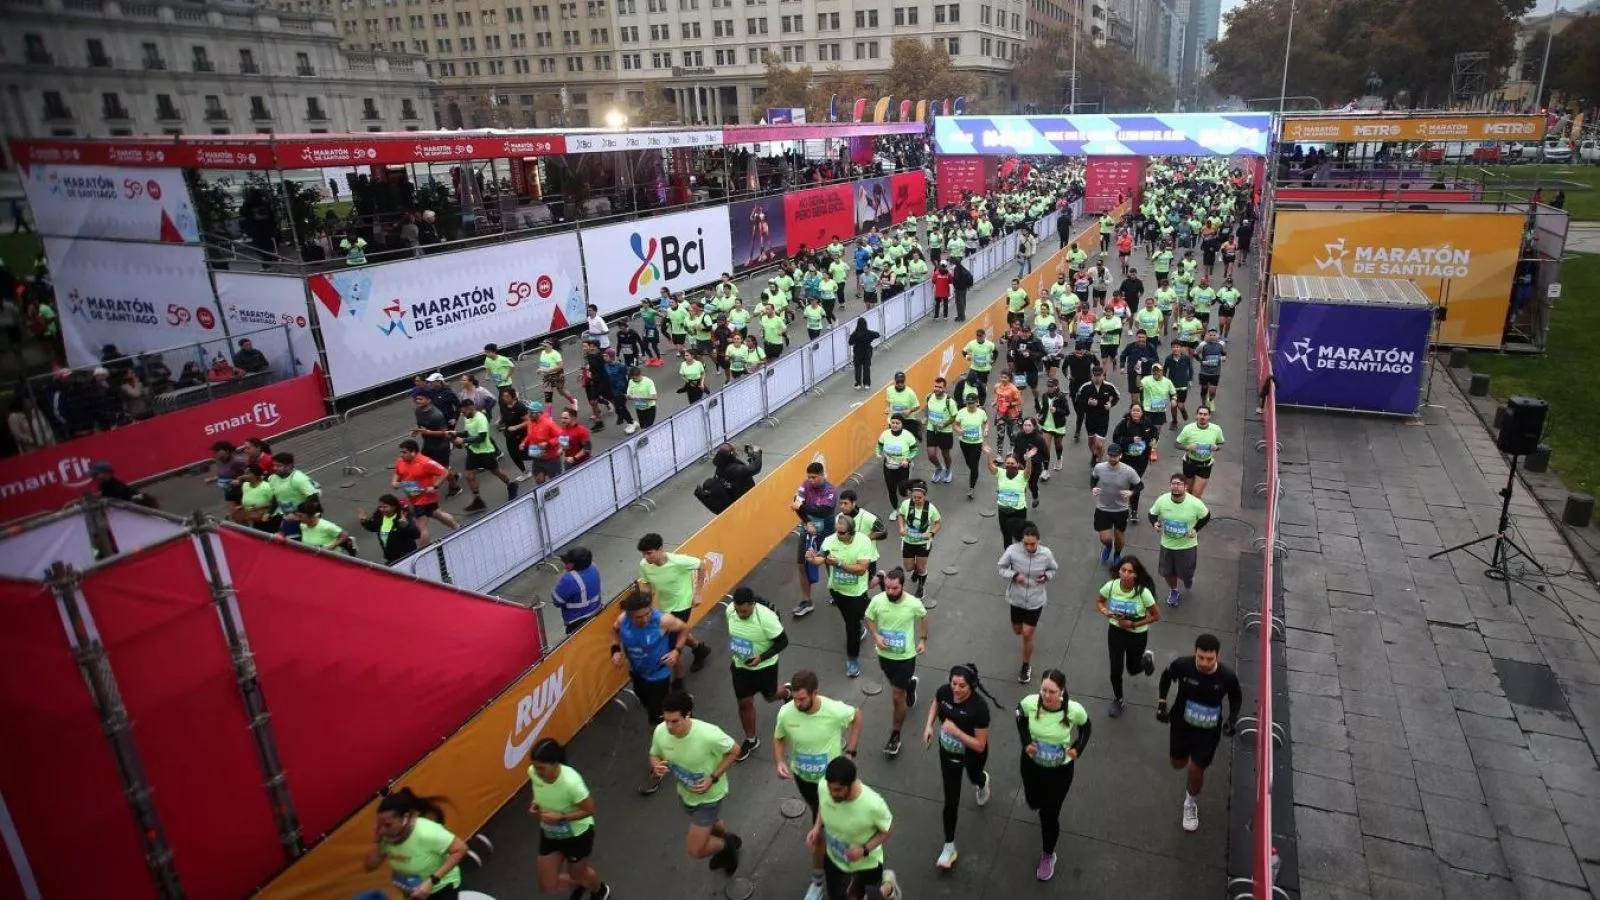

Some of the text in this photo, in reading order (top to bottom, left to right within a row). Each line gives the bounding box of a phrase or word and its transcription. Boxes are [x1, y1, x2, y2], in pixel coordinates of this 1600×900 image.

[63, 174, 115, 189] MARATÓN
[660, 227, 704, 280] Bci
[1356, 244, 1470, 264] MARATÓN
[1354, 263, 1468, 278] DE SANTIAGO
[88, 297, 155, 314] MARATÓN
[411, 286, 494, 319] MARATÓN
[90, 311, 158, 326] DE SANTIAGO
[239, 308, 276, 319] MARATÓN
[416, 302, 496, 332] DE SANTIAGO
[1318, 346, 1414, 364] MARATÓN
[1317, 359, 1412, 374] DE SANTIAGO
[204, 402, 280, 436] smart fit
[0, 456, 91, 498] mart fit
[515, 664, 564, 736] RUN
